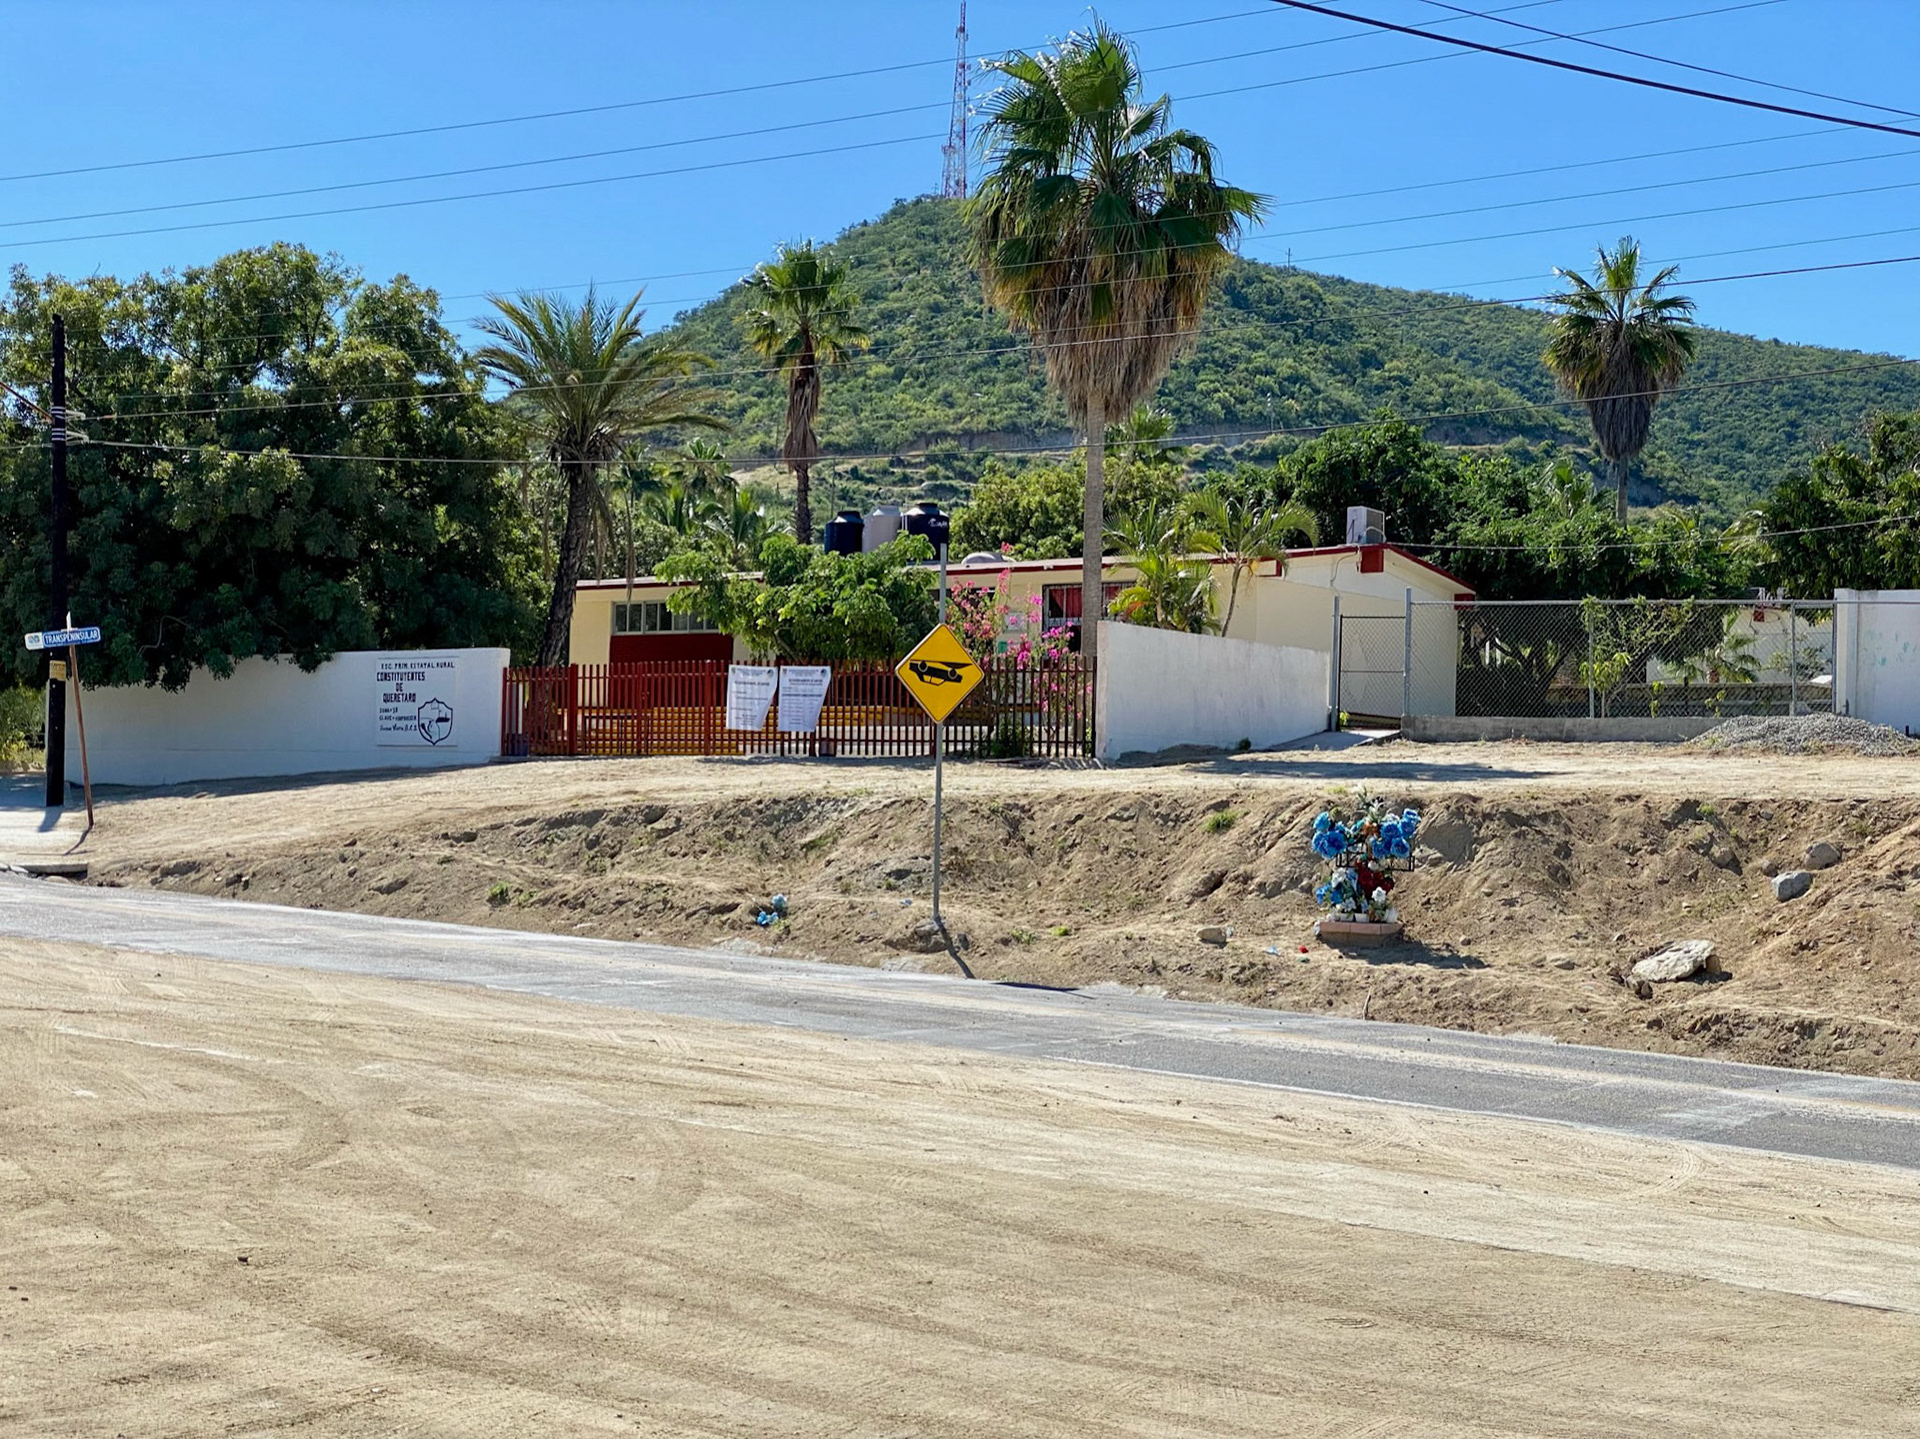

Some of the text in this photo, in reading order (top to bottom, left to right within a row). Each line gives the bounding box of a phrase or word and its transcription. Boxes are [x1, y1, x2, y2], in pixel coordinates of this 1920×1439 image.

[45, 630, 98, 644] TRANSPENINSULAR
[395, 682, 403, 692] DE
[382, 693, 416, 704] QUERETARO
